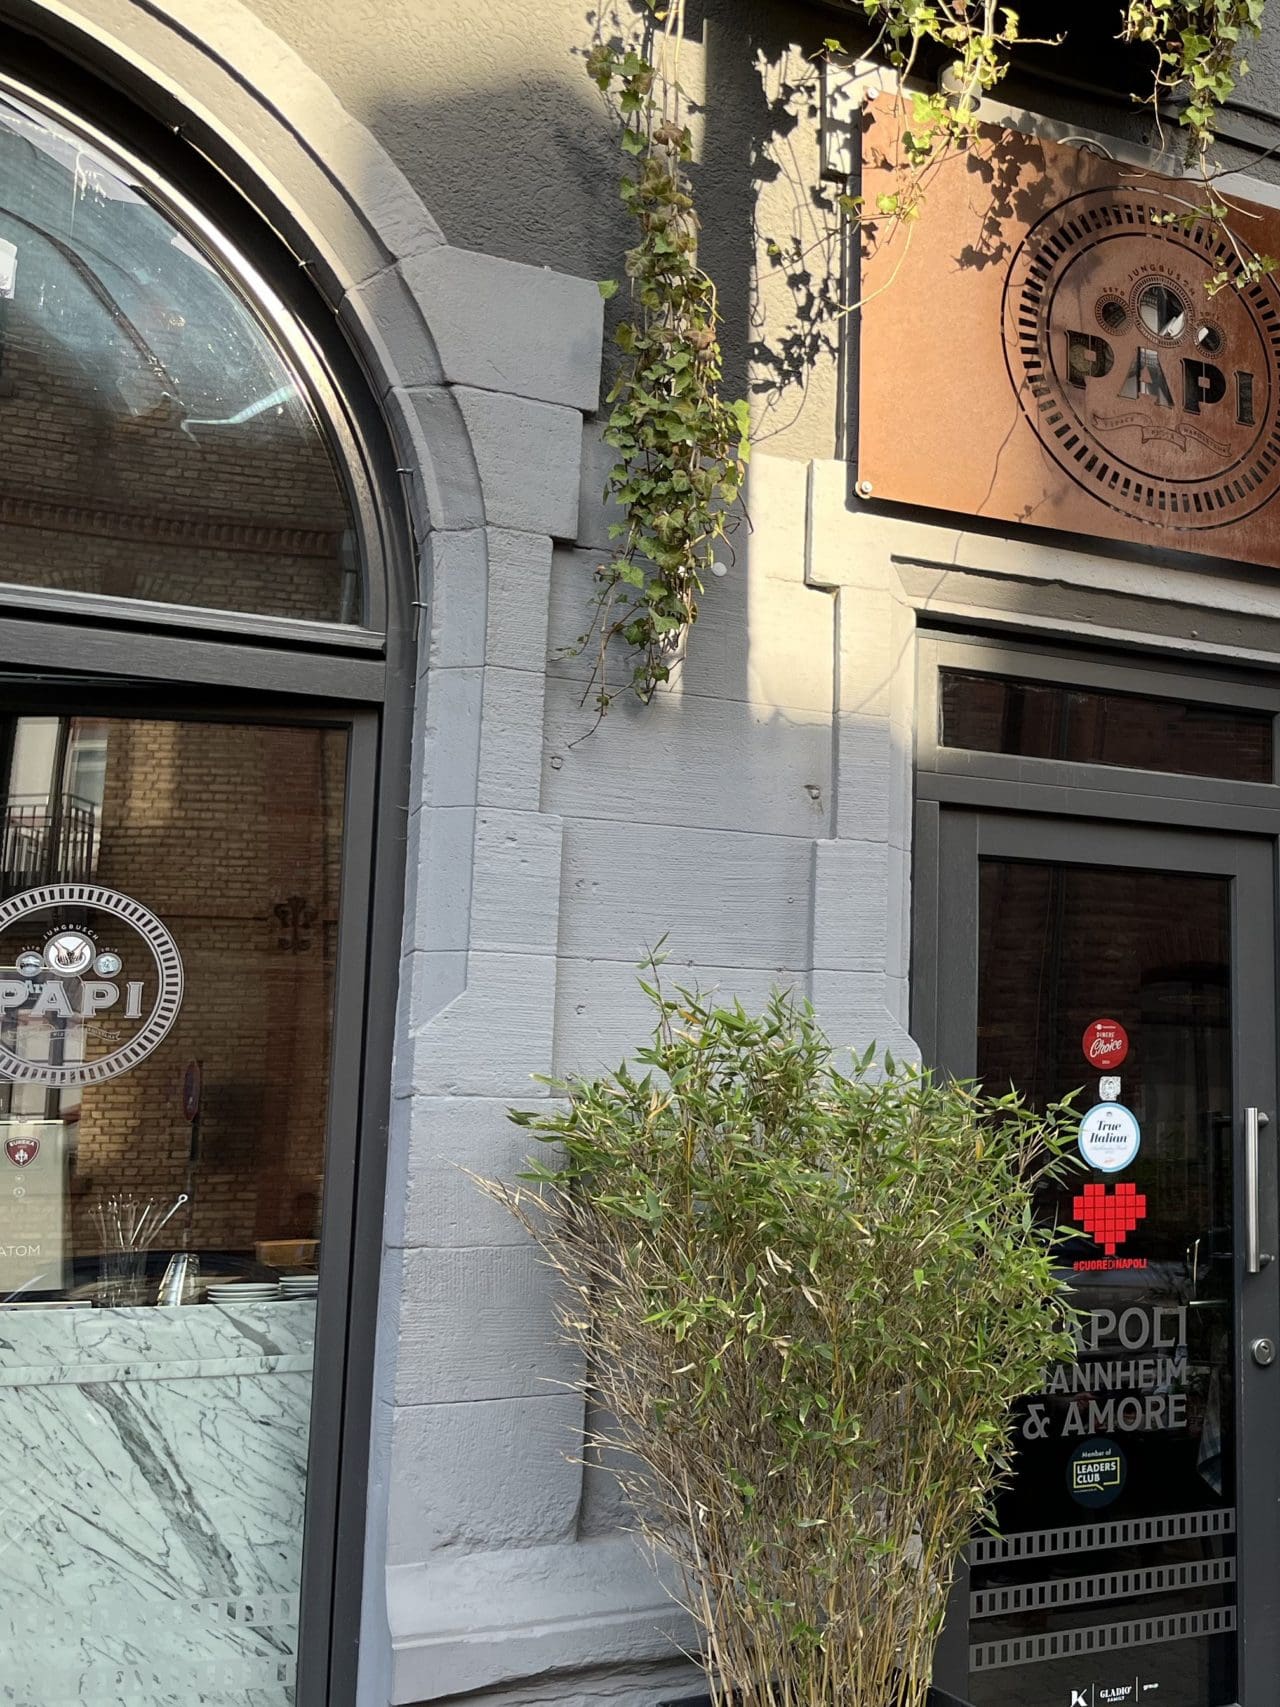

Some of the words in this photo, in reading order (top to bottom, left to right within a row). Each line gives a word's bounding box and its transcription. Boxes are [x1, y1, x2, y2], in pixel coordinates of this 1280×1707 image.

[1064, 330, 1256, 427] PAPI
[0, 979, 145, 1019] PAPI
[1089, 1037, 1123, 1058] Choice
[1097, 1120, 1122, 1131] True
[1089, 1132, 1128, 1144] Italian
[0, 1245, 41, 1258] ATOM
[1073, 1258, 1148, 1272] #CUOREDINAPOLI
[1022, 1403, 1050, 1440] &
[1061, 1393, 1188, 1437] AMORE
[1081, 1450, 1104, 1458] Member
[1105, 1448, 1112, 1456] of
[1076, 1462, 1117, 1475] LEADERS
[1076, 1473, 1101, 1484] CLUB
